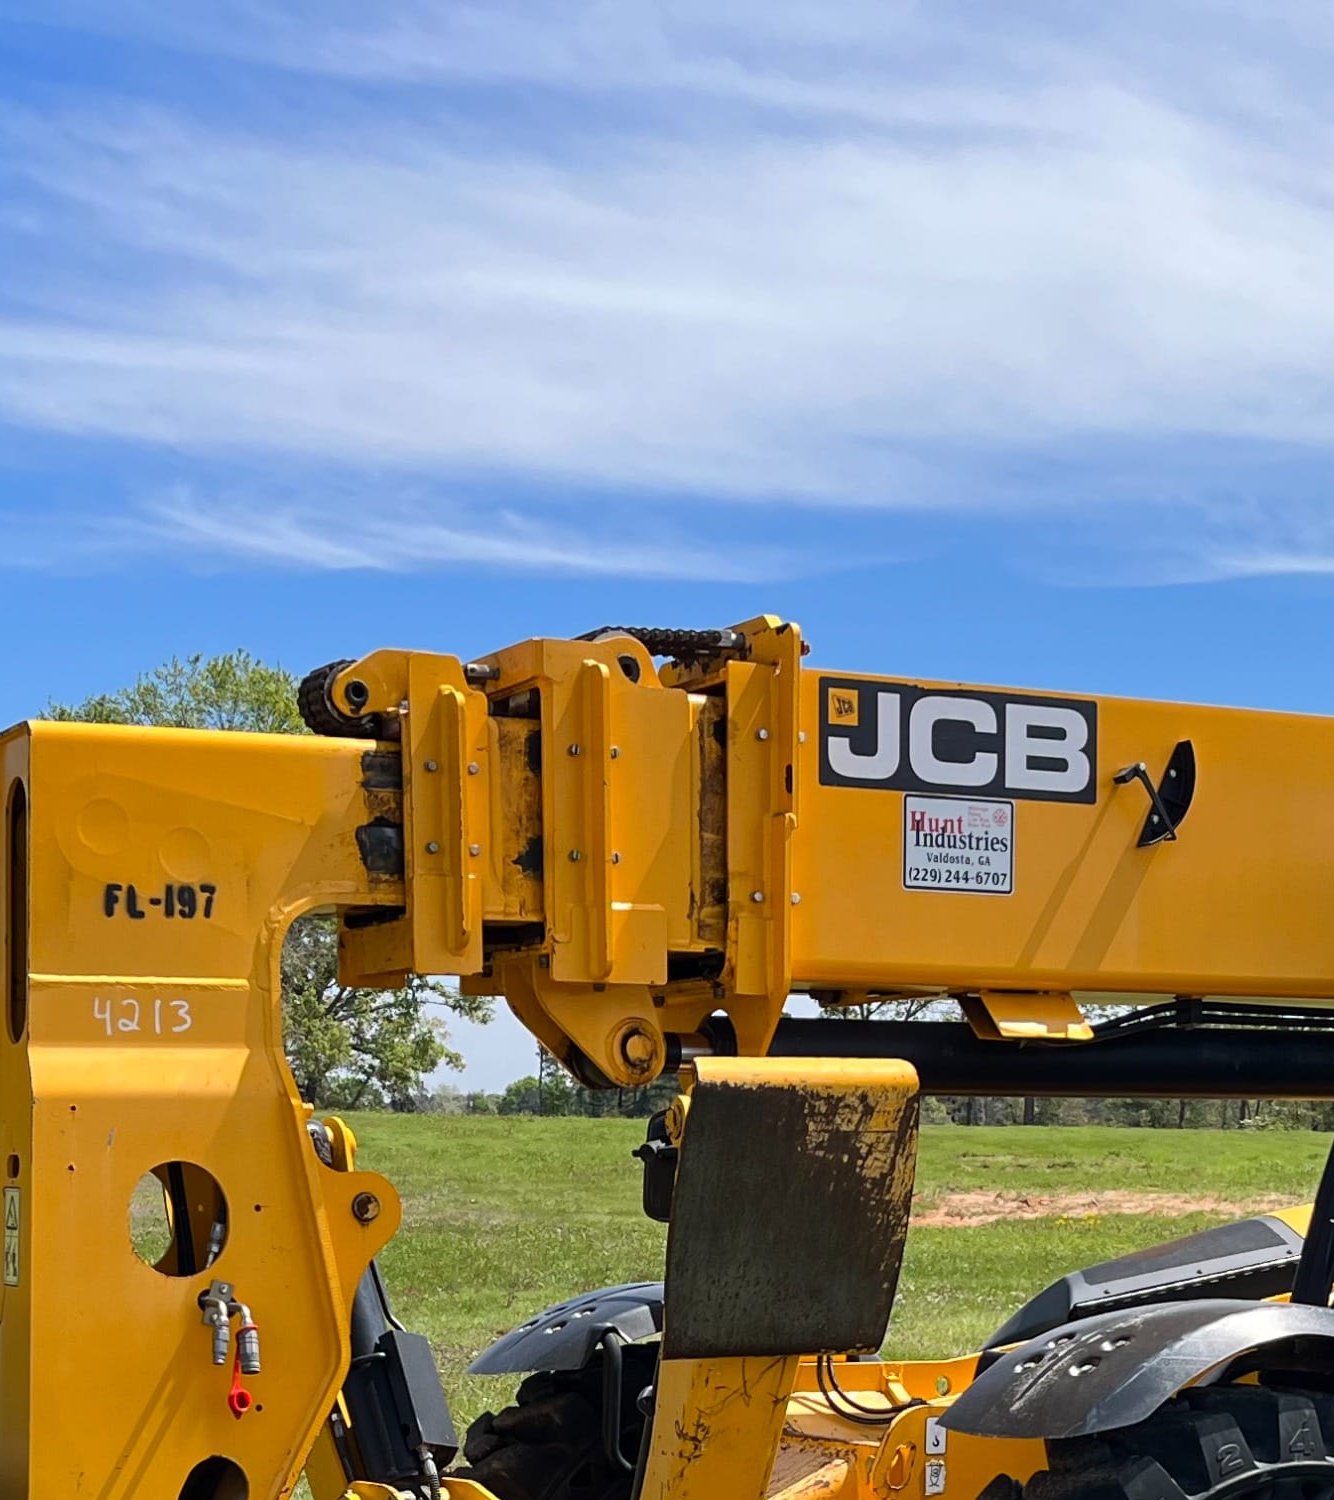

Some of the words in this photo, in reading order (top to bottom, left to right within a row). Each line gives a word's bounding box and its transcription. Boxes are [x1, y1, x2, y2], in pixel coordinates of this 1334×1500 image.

[827, 691, 1090, 793] JCB
[910, 810, 964, 835] Hunt
[914, 819, 1009, 853] Industries
[908, 866, 942, 884] (229)
[945, 869, 1008, 887] 244-6707
[978, 855, 992, 867] GA
[103, 883, 217, 920] FL-197
[93, 997, 194, 1036] 4213
